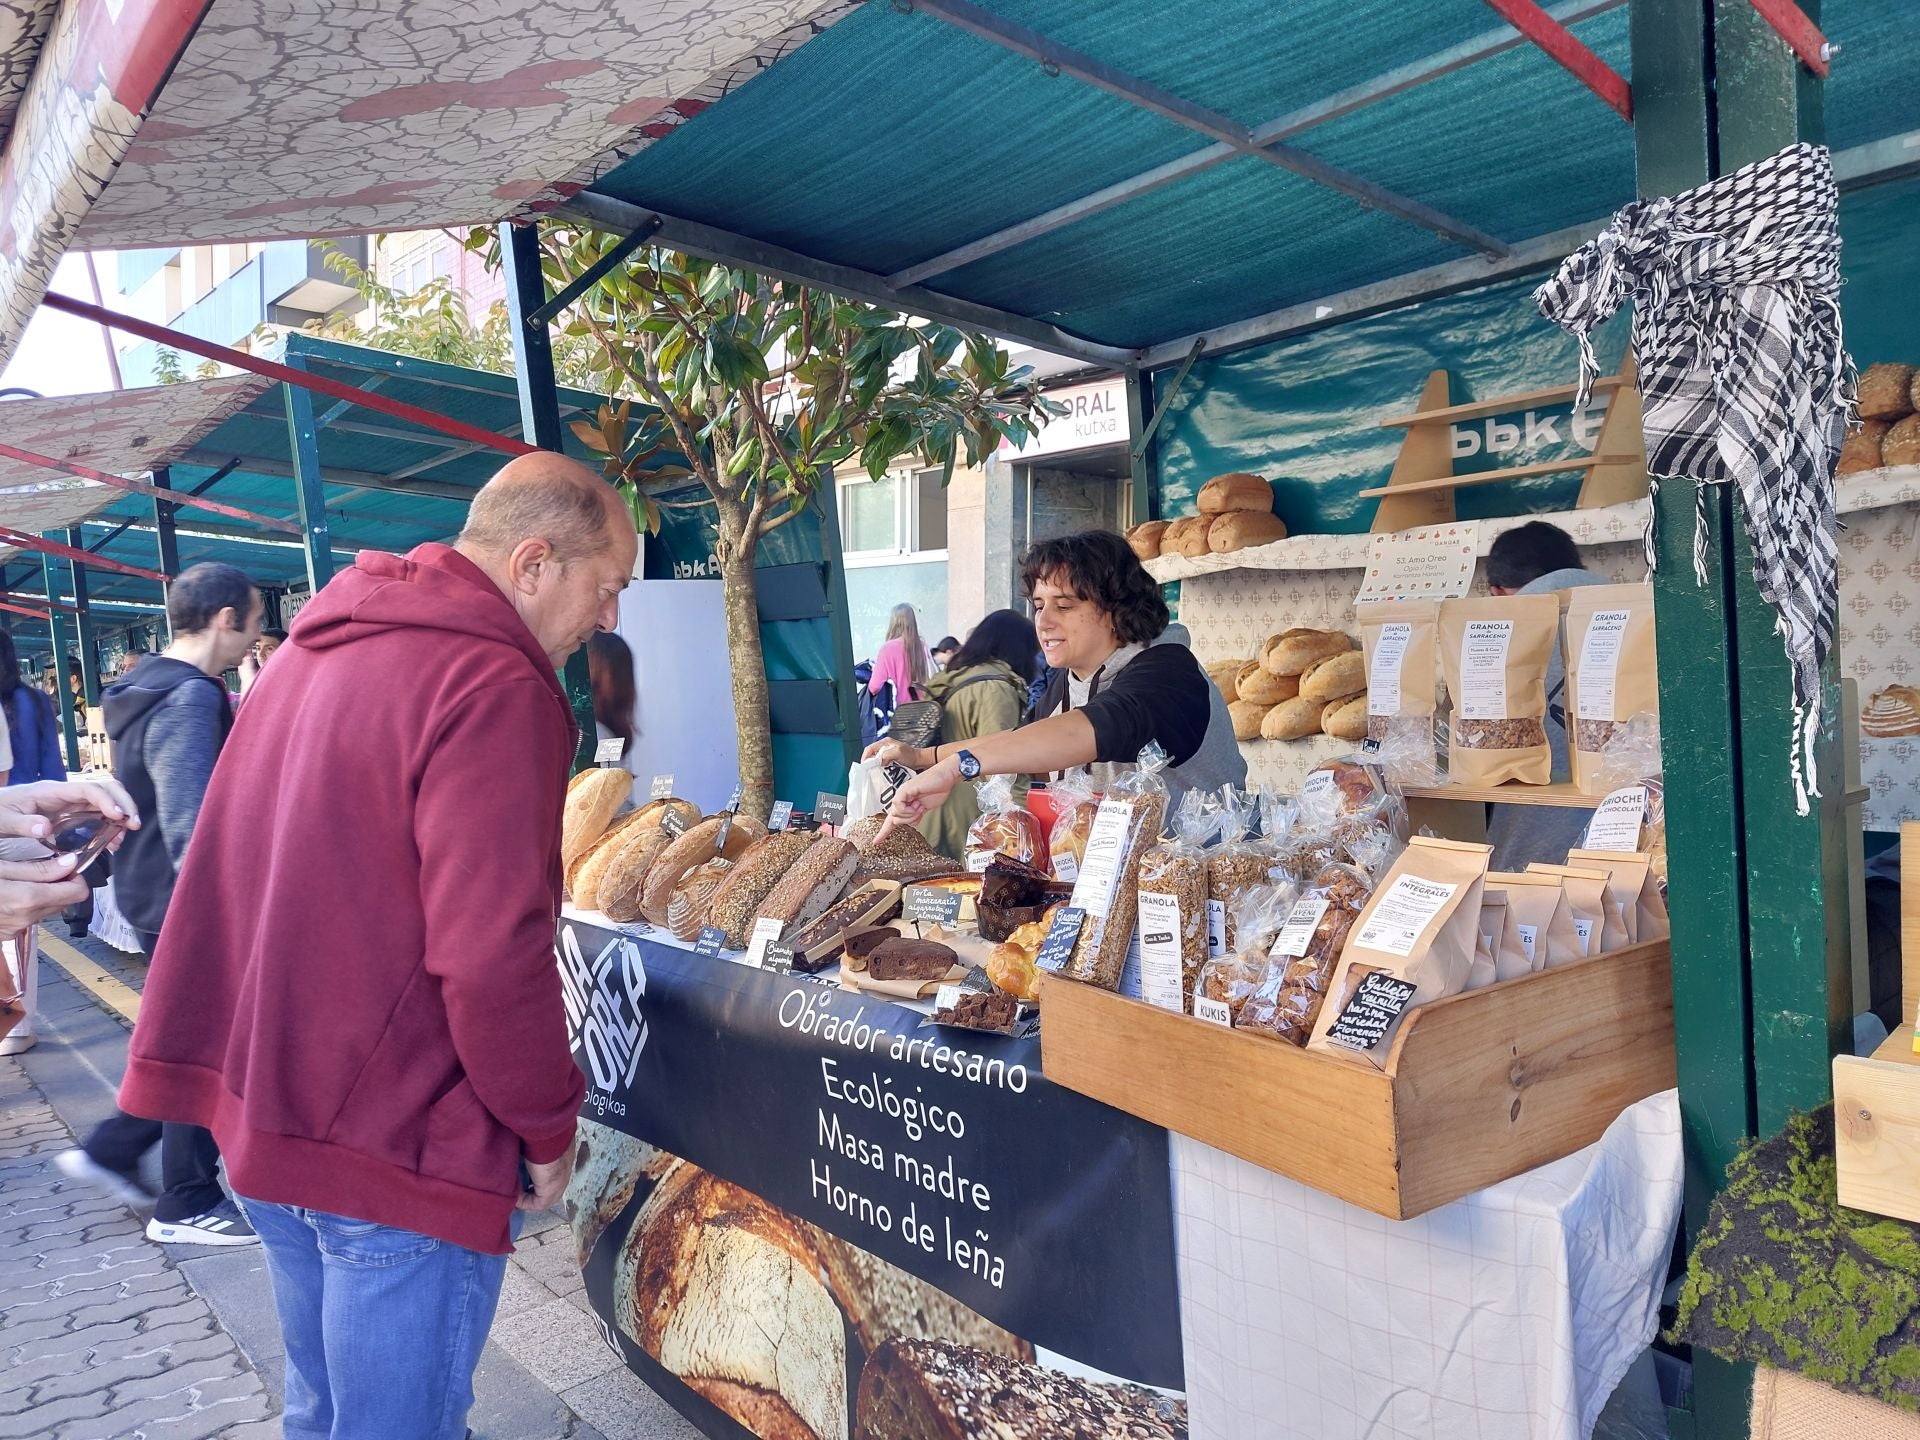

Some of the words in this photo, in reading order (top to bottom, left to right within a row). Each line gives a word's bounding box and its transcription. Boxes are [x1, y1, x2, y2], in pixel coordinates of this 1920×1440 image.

[1075, 418, 1116, 437] kutxa
[1595, 613, 1627, 622] GRANOLA
[1384, 625, 1410, 633] GRANOLA
[912, 888, 934, 897] Torta
[1399, 881, 1450, 898] INTEGRALES
[1140, 895, 1176, 907] GRANOLA
[1293, 909, 1316, 917] AVENA
[584, 941, 647, 1093] OREA
[1200, 1004, 1227, 1022] KUKIS
[1341, 1015, 1390, 1030] variedad
[778, 989, 886, 1053] Obrador
[890, 1034, 1027, 1094] artesano
[821, 1057, 965, 1141] Ecológico
[818, 1107, 885, 1171] Masa
[894, 1152, 991, 1212] madre
[810, 1158, 892, 1232] Horno
[901, 1201, 935, 1253] de
[945, 1216, 1006, 1289] leña
